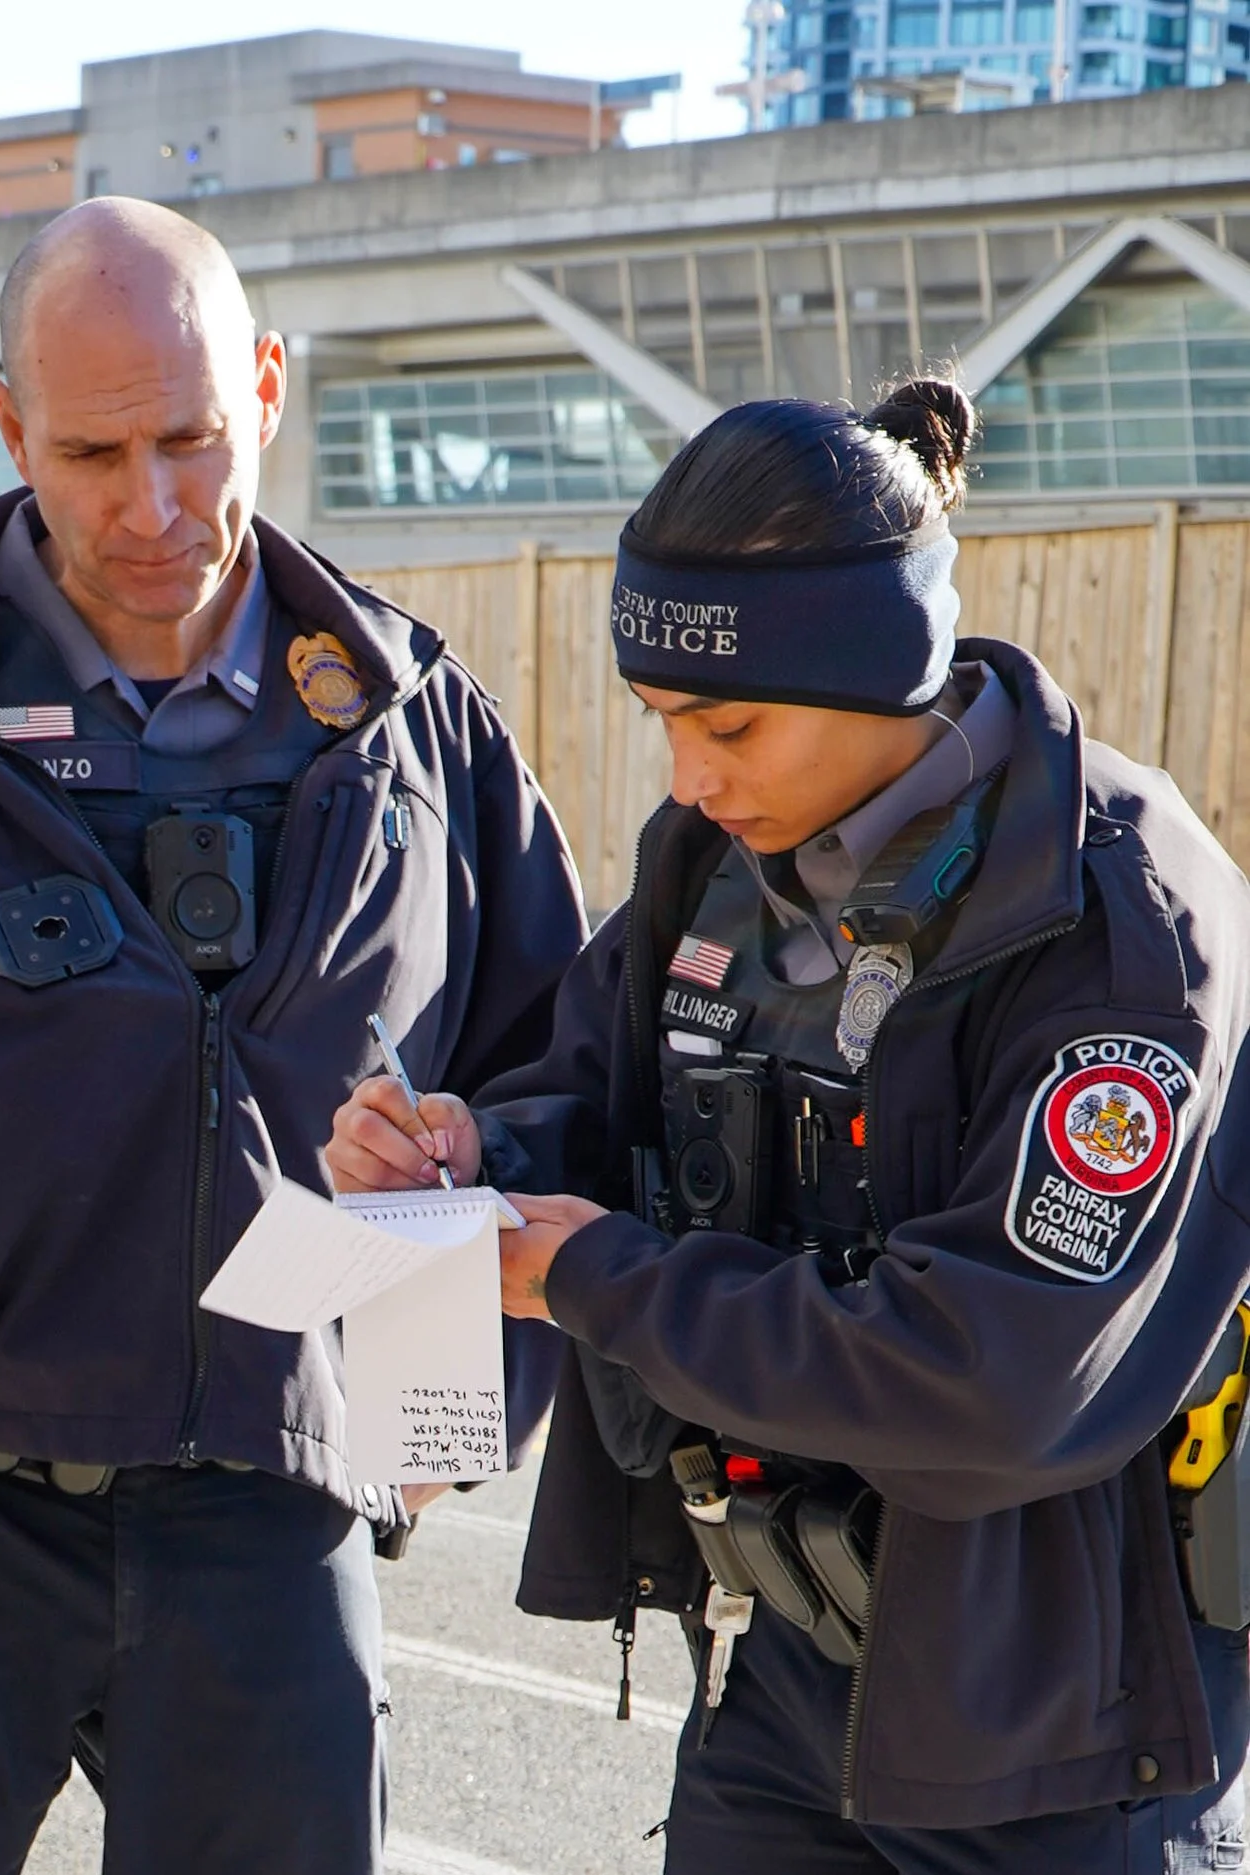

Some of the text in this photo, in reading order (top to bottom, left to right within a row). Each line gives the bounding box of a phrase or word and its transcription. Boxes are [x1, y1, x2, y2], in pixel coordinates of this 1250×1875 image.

[612, 604, 738, 655] POLICE
[661, 600, 738, 626] COUNTY
[195, 945, 222, 954] AXON
[1075, 1041, 1187, 1097] POLICE
[1064, 1067, 1169, 1133] COUNTY OF FAIRFAX
[1066, 1155, 1120, 1191] VIRGINIA
[1086, 1153, 1113, 1171] 1742
[1030, 1197, 1120, 1248] COUNTY
[1040, 1175, 1127, 1228] FAIRFAX
[1025, 1216, 1109, 1272] VIRGINIA
